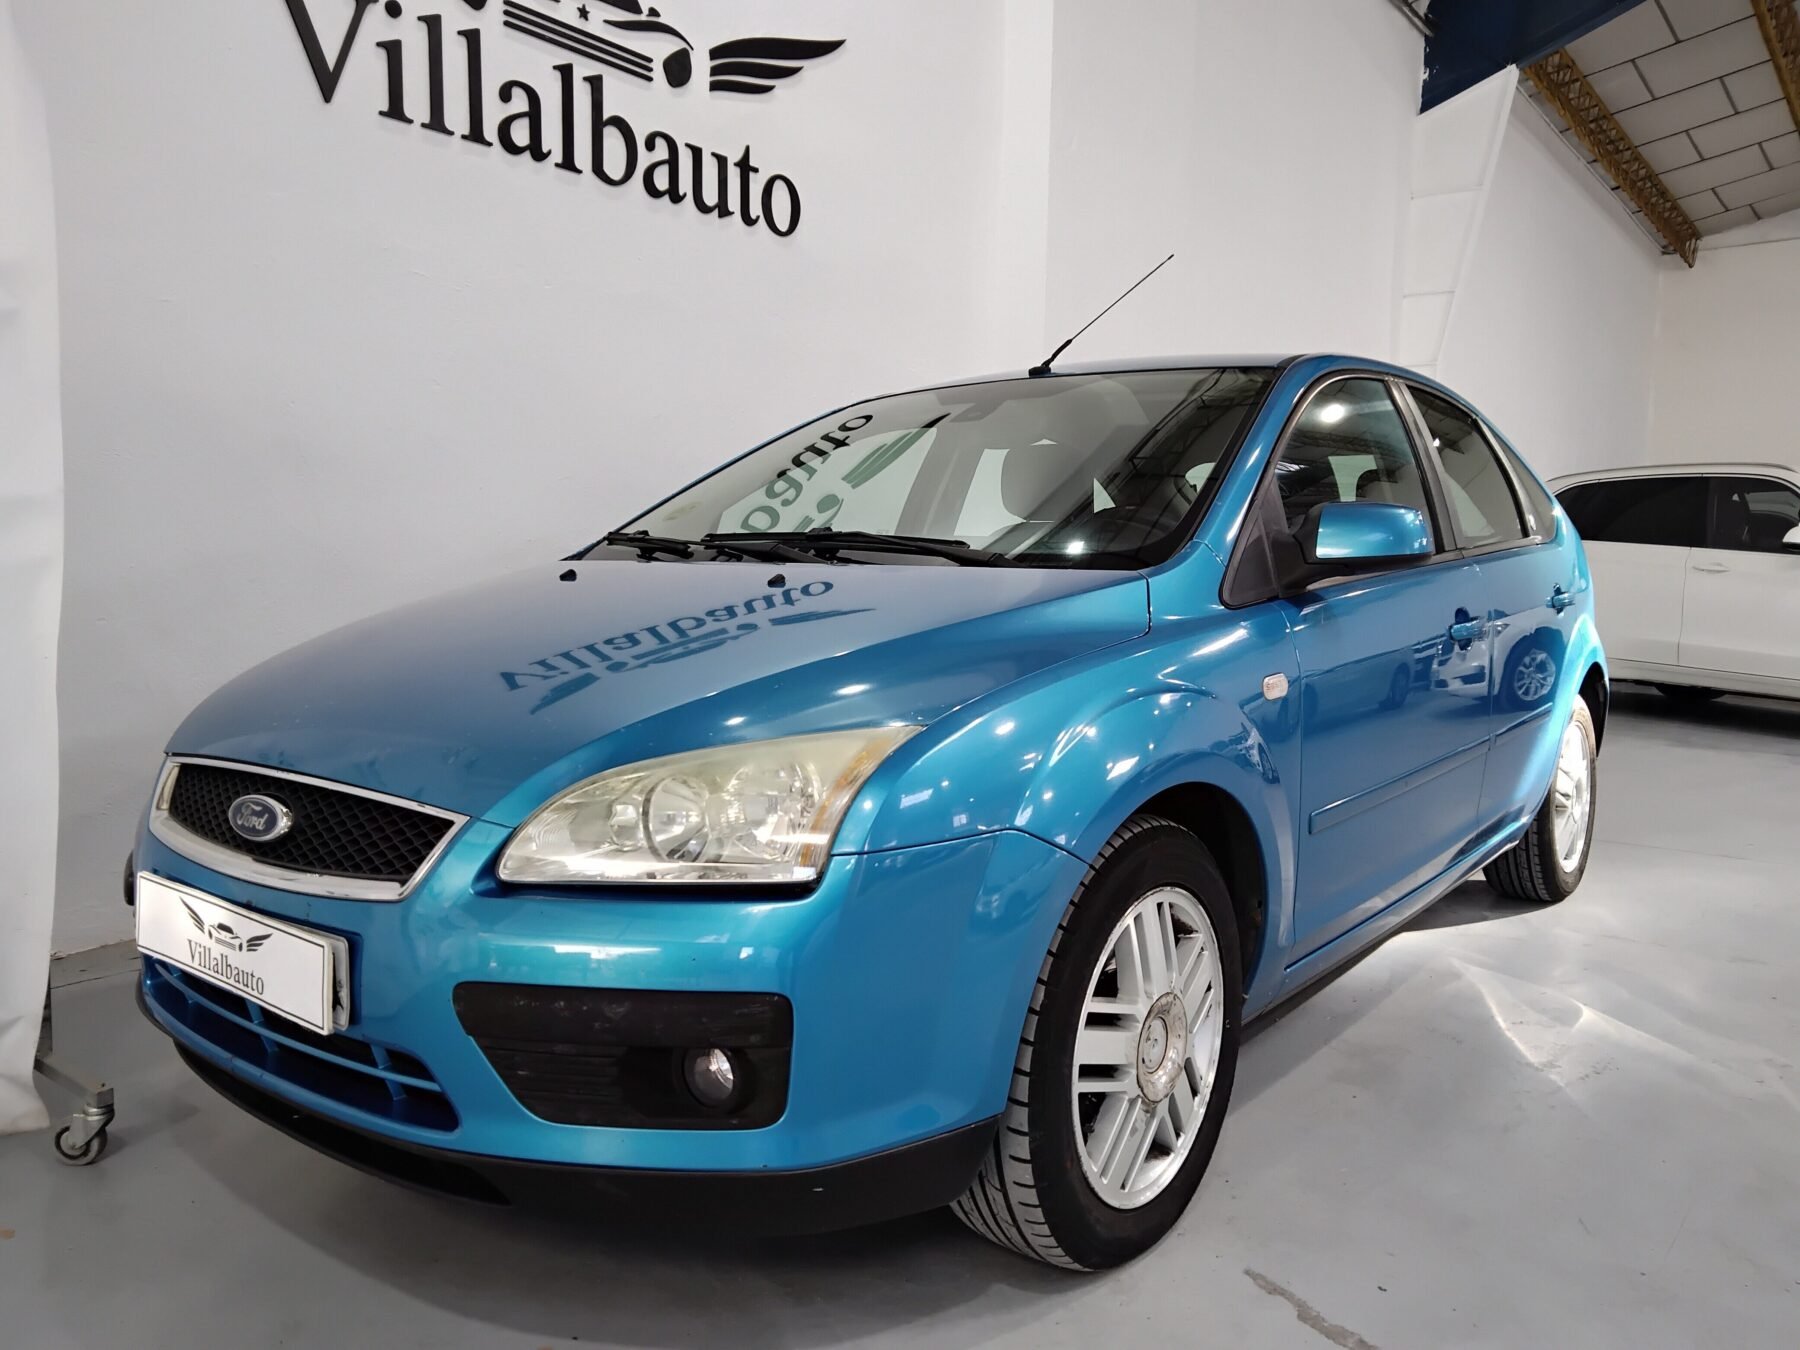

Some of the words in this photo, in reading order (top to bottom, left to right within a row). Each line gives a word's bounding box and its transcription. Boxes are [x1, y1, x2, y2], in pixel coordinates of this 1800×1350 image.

[285, 0, 801, 237] Villalbauto
[237, 802, 269, 830] Ford
[187, 939, 264, 995] Villalbauto
